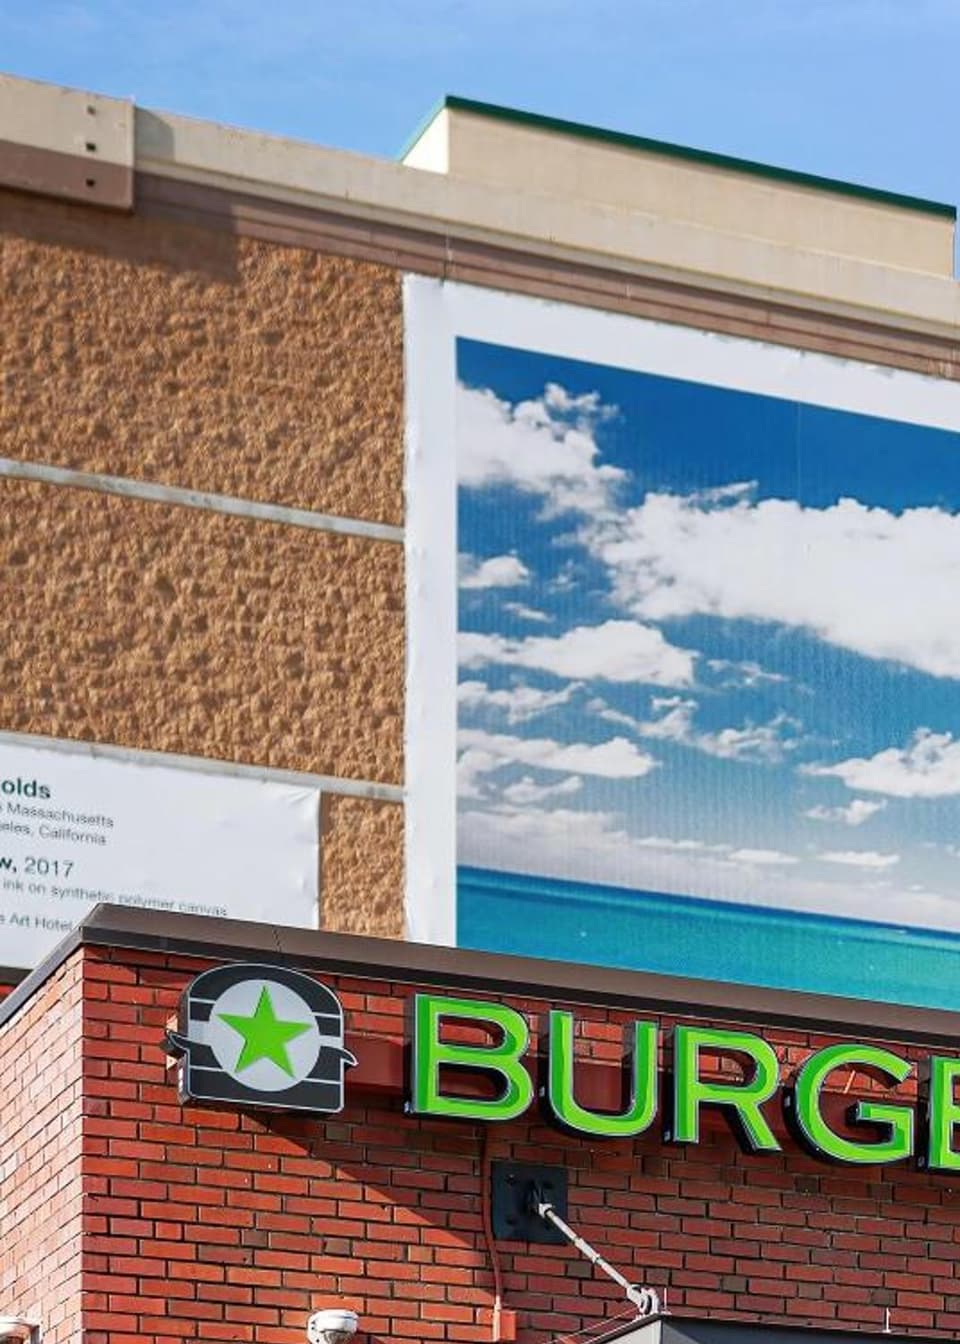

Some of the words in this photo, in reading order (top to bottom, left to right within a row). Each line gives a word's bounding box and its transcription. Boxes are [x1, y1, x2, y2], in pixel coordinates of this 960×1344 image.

[1, 778, 51, 799] olds
[7, 802, 114, 828] Massachusetts
[39, 824, 106, 846] California
[25, 857, 74, 878] 2017
[3, 878, 24, 892] ink
[28, 883, 46, 895] on
[10, 913, 30, 927] Art
